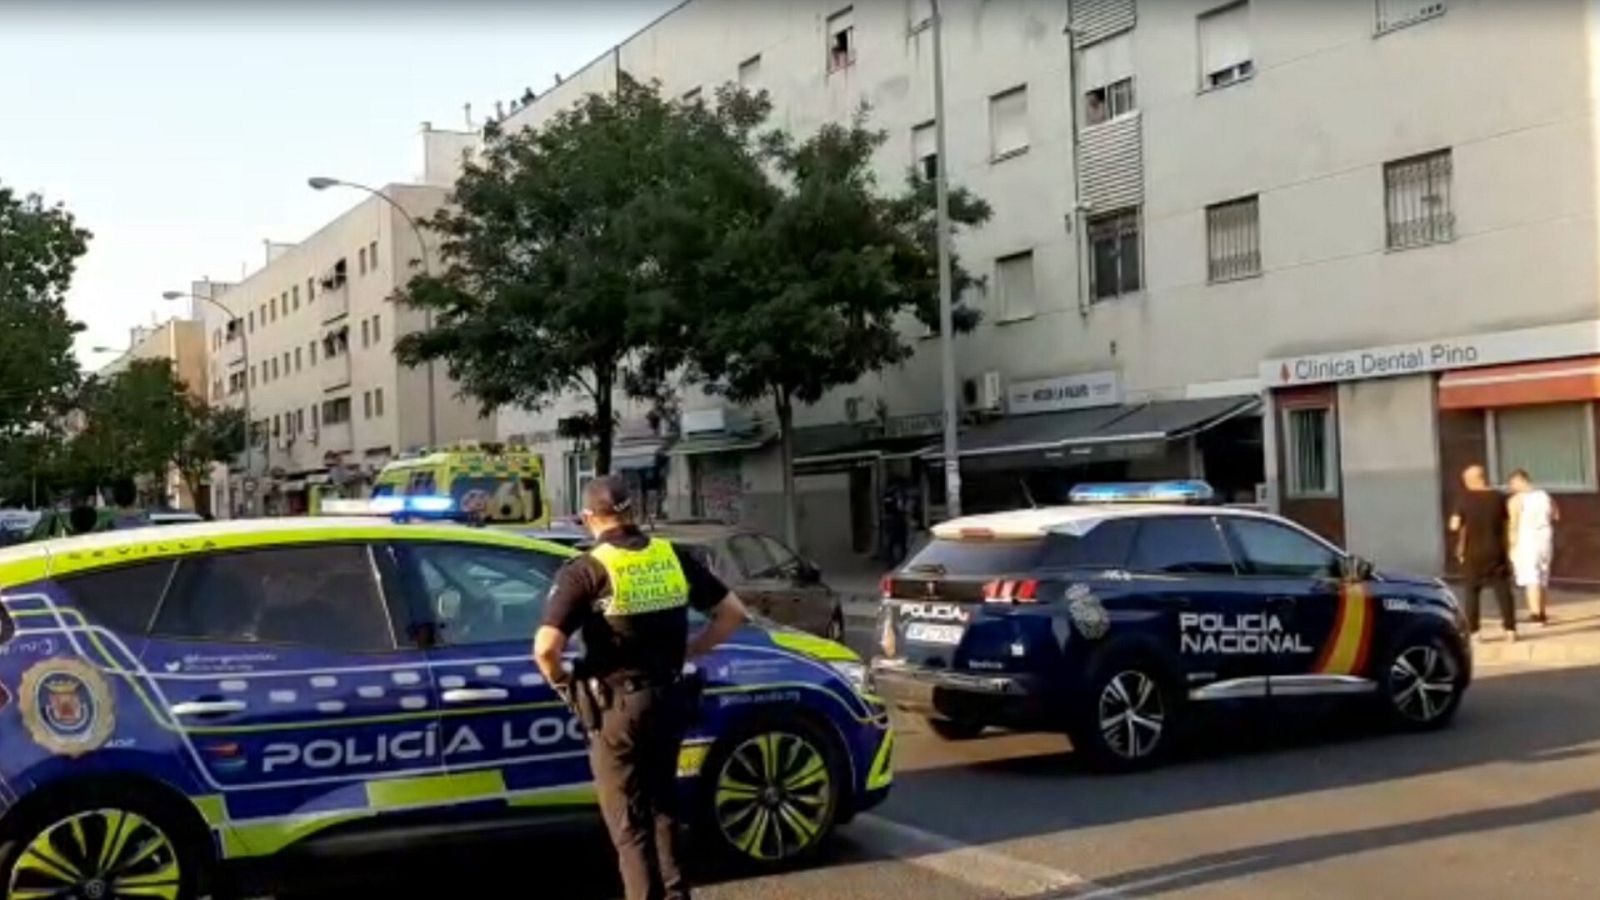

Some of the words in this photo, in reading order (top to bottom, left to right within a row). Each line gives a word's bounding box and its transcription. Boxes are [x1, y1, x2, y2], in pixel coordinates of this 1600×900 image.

[1295, 358, 1356, 380] Clinica
[1361, 346, 1424, 374] Dental
[1431, 344, 1479, 366] Pino
[69, 540, 217, 559] SEVILLA
[631, 574, 665, 586] LOCAL
[620, 583, 681, 602] SEVILLA
[1180, 633, 1314, 653] NACIONAL
[263, 720, 484, 774] POLICÍA
[502, 716, 584, 749] LOC
